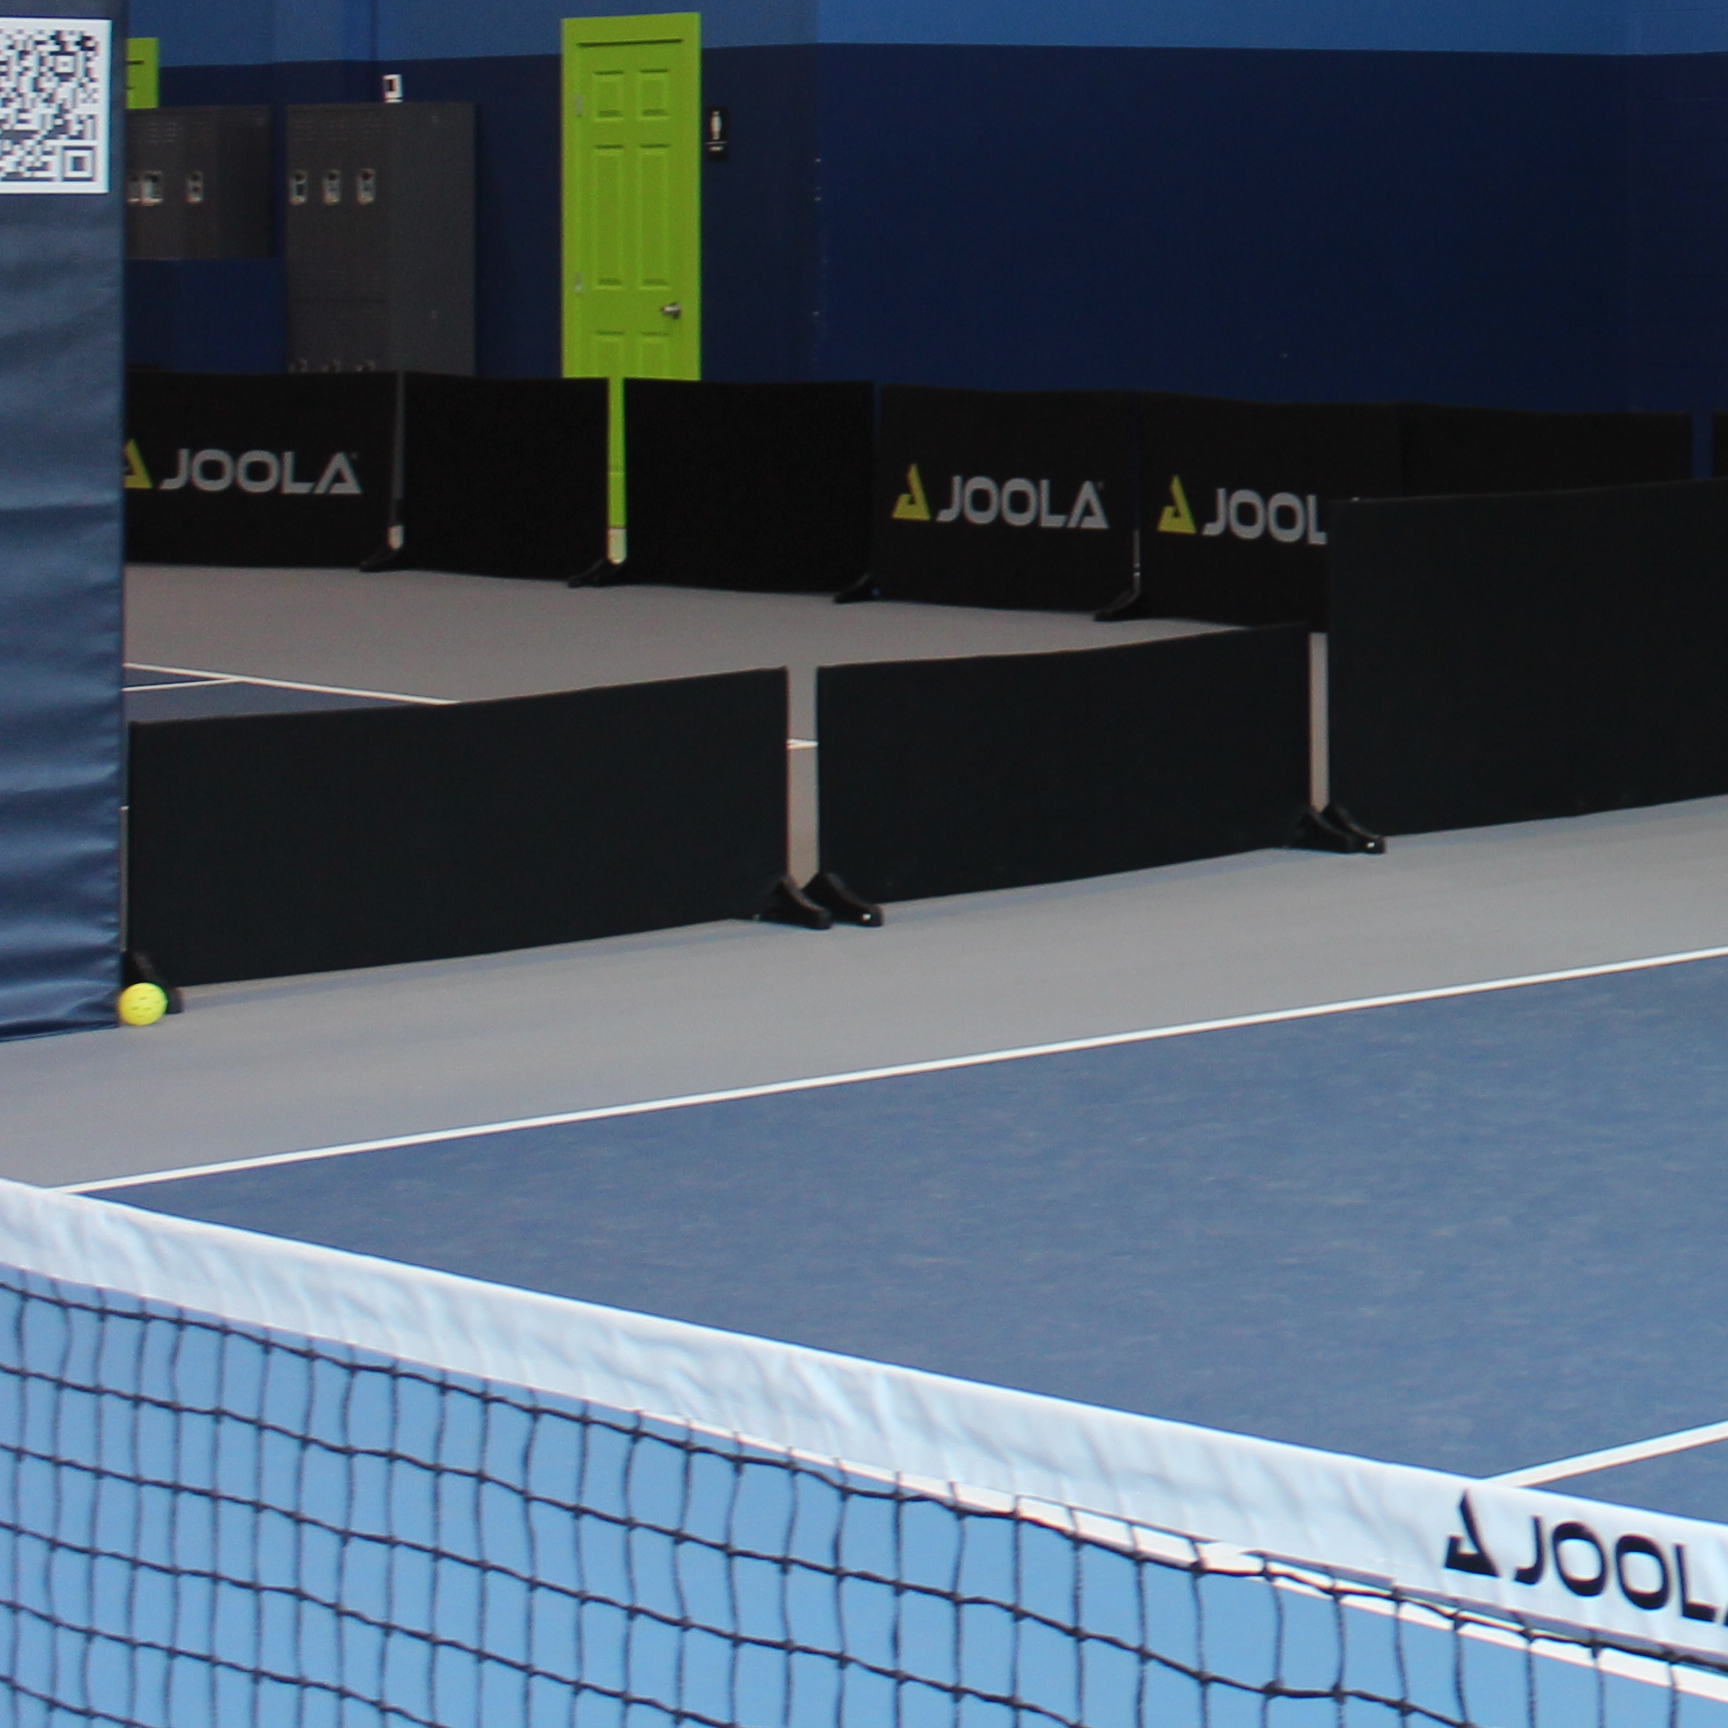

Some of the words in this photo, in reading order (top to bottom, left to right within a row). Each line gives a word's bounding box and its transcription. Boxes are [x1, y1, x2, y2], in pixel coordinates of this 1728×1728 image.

[159, 448, 362, 494] JOOLA
[936, 475, 1110, 529] JOOLA
[1202, 487, 1327, 545] JOOL
